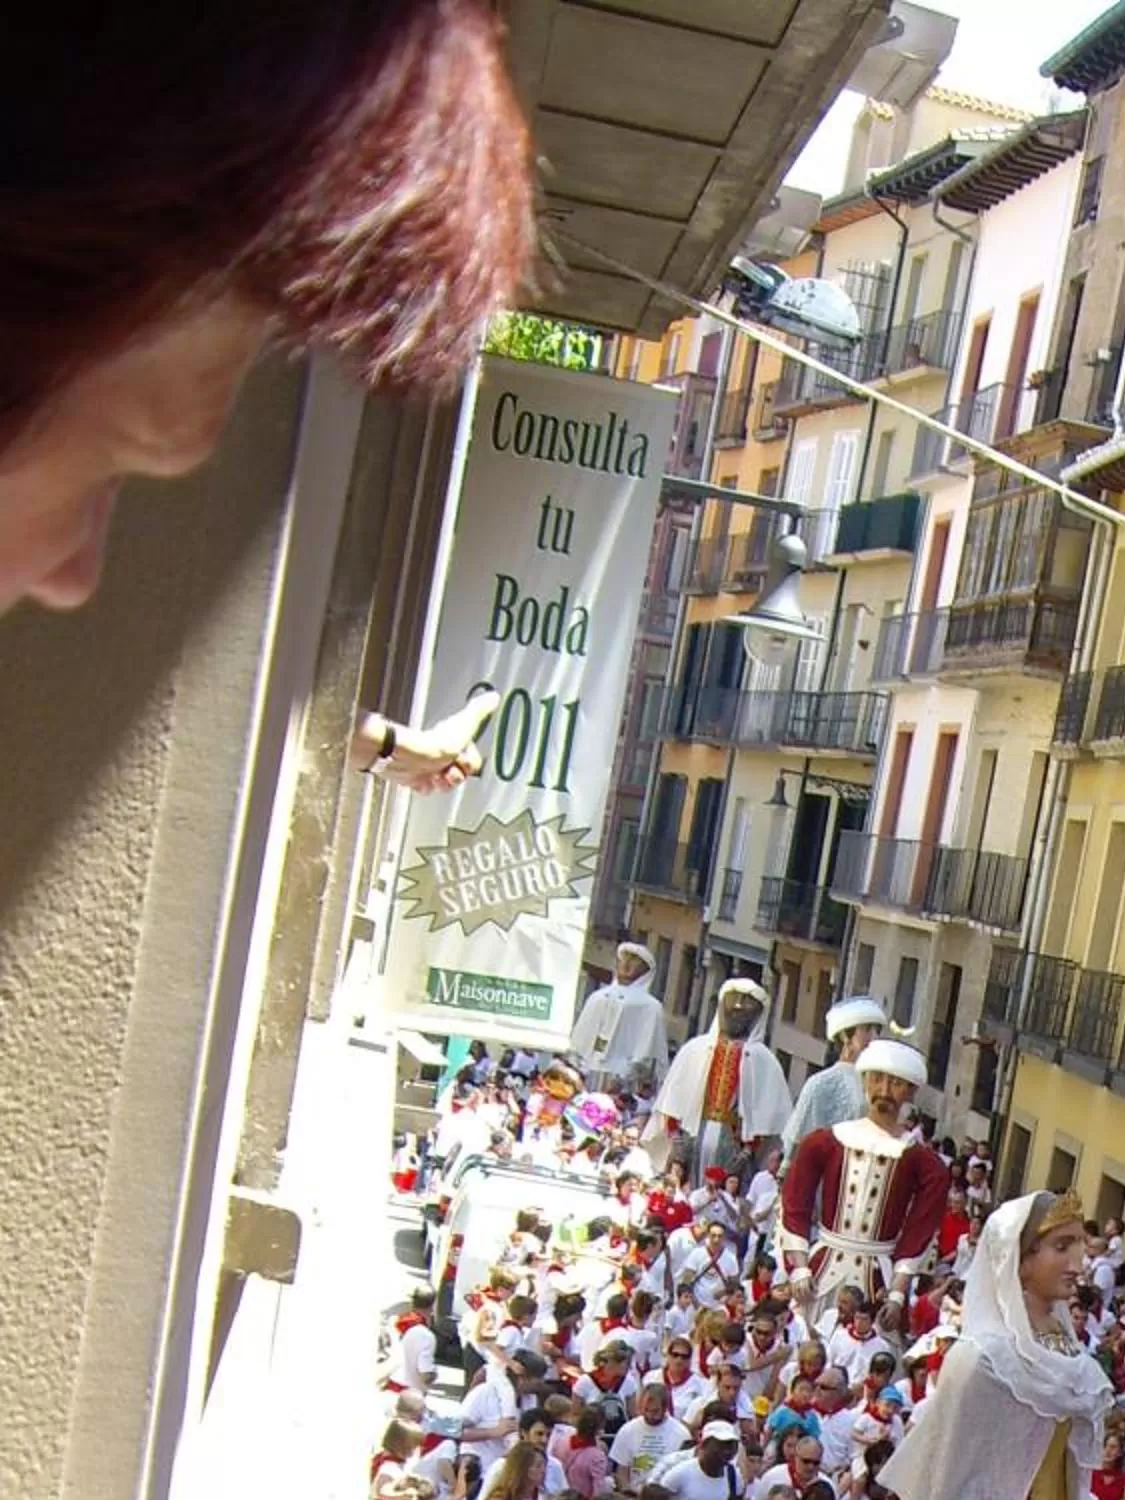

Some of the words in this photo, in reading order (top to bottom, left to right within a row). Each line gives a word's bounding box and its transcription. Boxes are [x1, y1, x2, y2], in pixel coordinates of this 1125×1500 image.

[491, 391, 649, 479] Consulta
[536, 493, 576, 556] tu
[484, 572, 592, 657] Boda
[432, 825, 559, 883] REGALO
[439, 858, 569, 917] SEGURO
[434, 969, 549, 1011] Maisonnave
